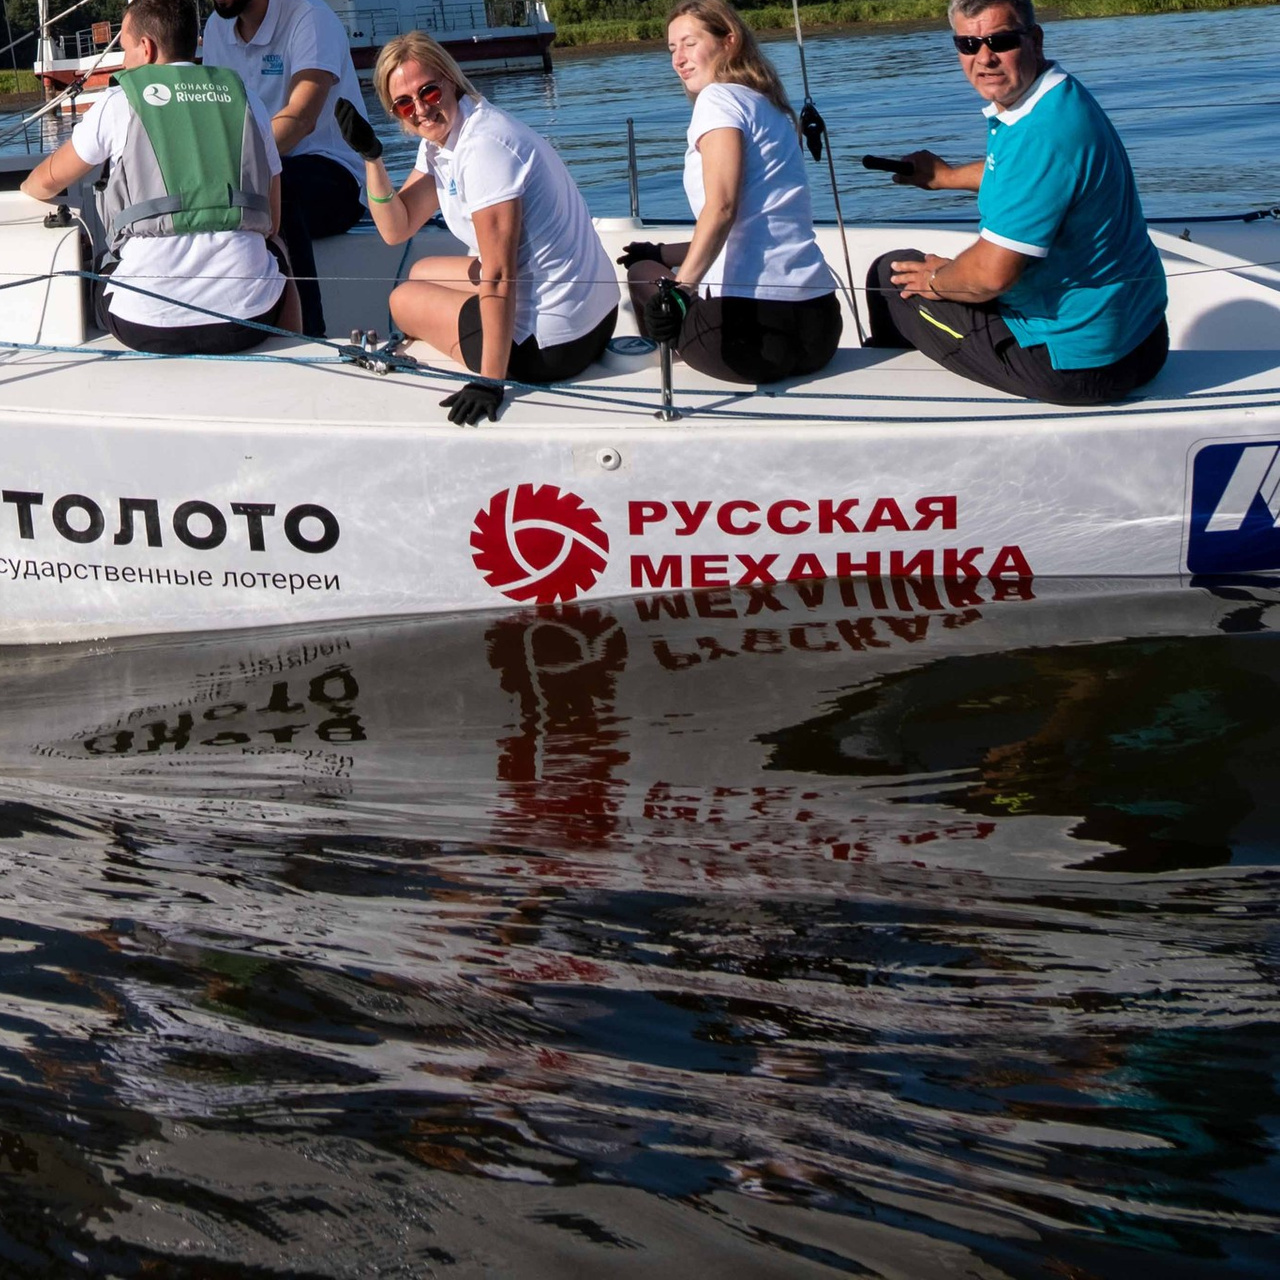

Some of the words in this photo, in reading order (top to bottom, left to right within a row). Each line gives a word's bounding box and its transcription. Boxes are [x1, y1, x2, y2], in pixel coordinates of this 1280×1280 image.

[174, 83, 229, 92] КОНАКОВО
[176, 91, 232, 103] RiverClub
[628, 495, 958, 536] РУССКАЯ
[630, 545, 1034, 588] МЕХАНИКА
[222, 570, 341, 595] лотереи
